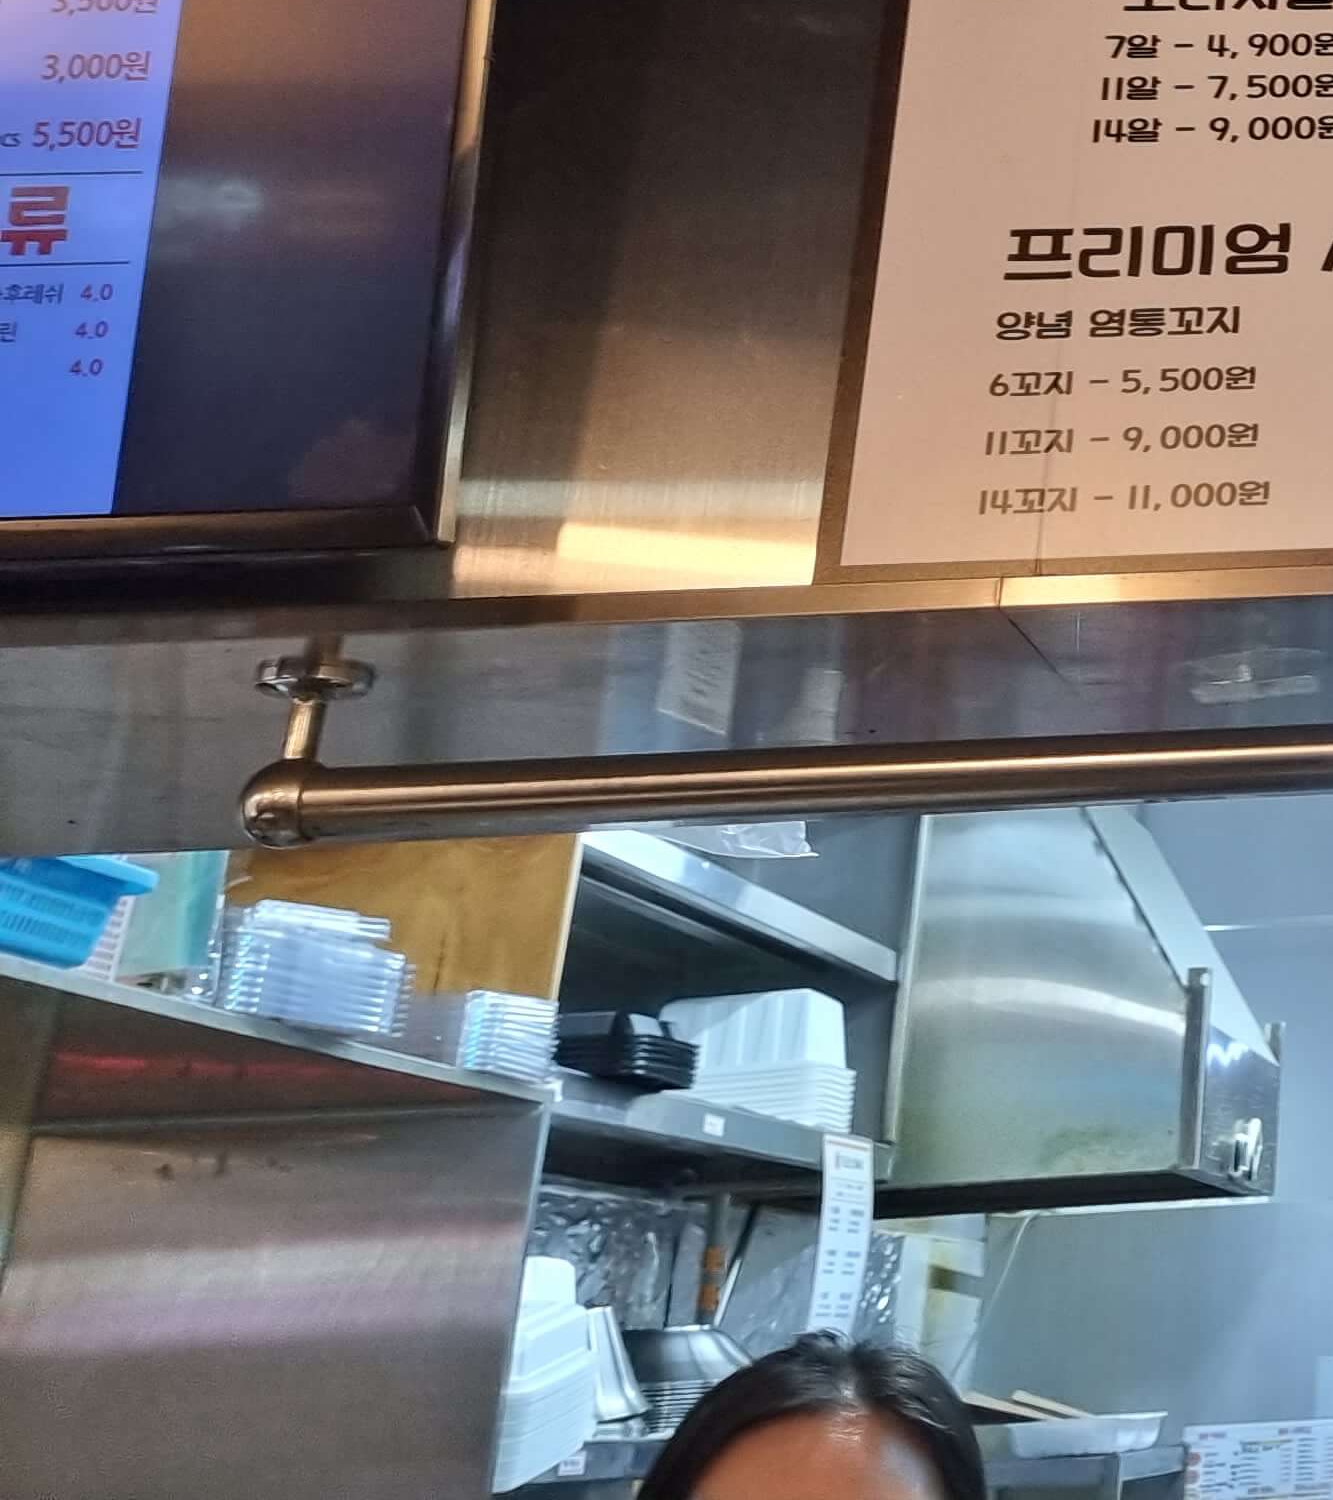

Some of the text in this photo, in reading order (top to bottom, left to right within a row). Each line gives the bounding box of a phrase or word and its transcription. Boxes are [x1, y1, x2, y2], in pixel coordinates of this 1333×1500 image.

[1105, 34, 1162, 59] 7알
[41, 50, 151, 85] 3,000원
[1101, 75, 1162, 101] 11알
[32, 117, 142, 150] 5,500원
[1092, 117, 1163, 144] 14알
[1003, 222, 1292, 281] 프리미엄
[0, 283, 114, 306] 후레쉬 4.0
[74, 319, 110, 340] 4.0
[995, 305, 1241, 341] 양념 염통꼬지
[69, 358, 104, 376] 4.0
[989, 370, 1074, 397] 6꼬지
[985, 428, 1074, 457] 11꼬지
[978, 486, 1078, 516] 14꼬지
